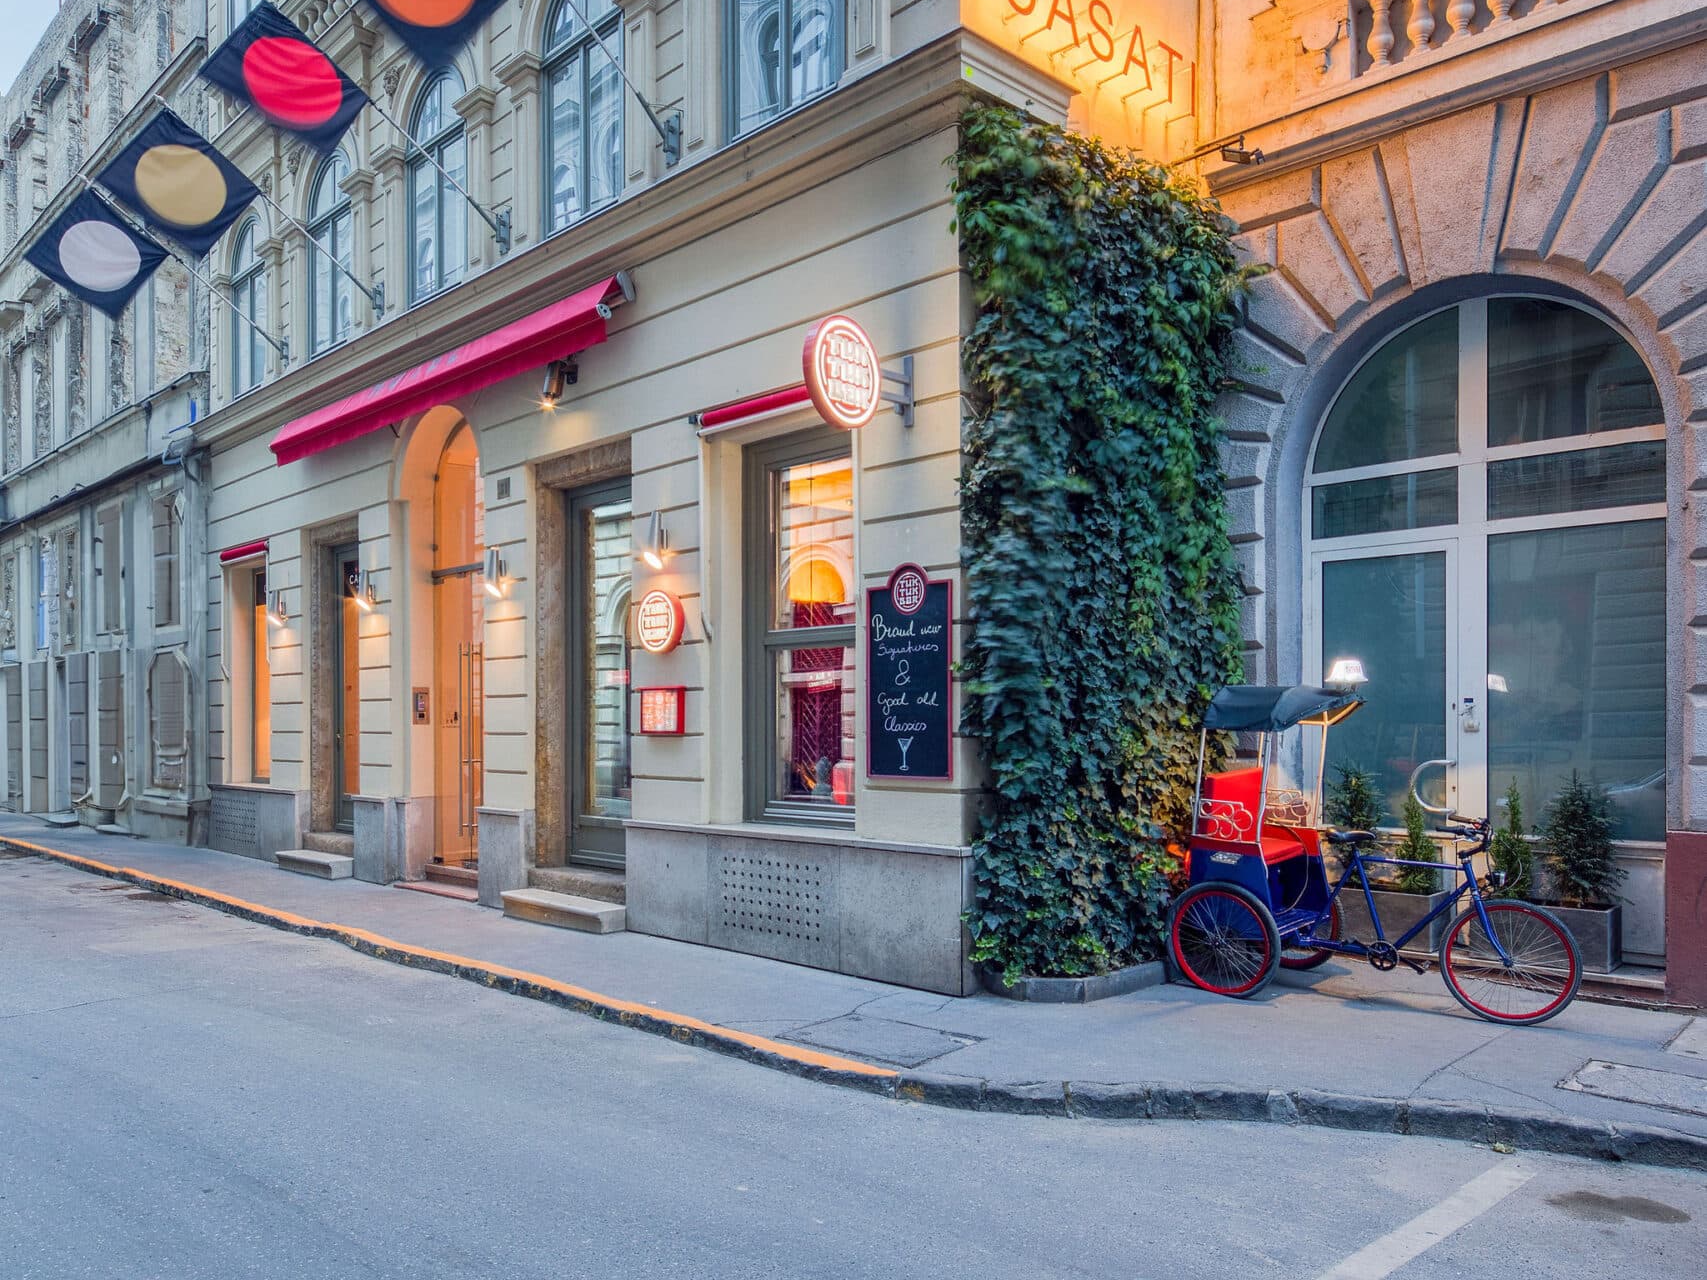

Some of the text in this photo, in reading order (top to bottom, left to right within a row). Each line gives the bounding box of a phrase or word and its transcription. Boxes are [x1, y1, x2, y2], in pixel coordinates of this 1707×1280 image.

[899, 587, 919, 597] TUK
[900, 578, 919, 588] TUK
[871, 614, 942, 641] Brand new
[877, 640, 939, 661] Signatures
[894, 659, 911, 686] &
[877, 691, 939, 716] Good old
[884, 715, 927, 732] Classics
